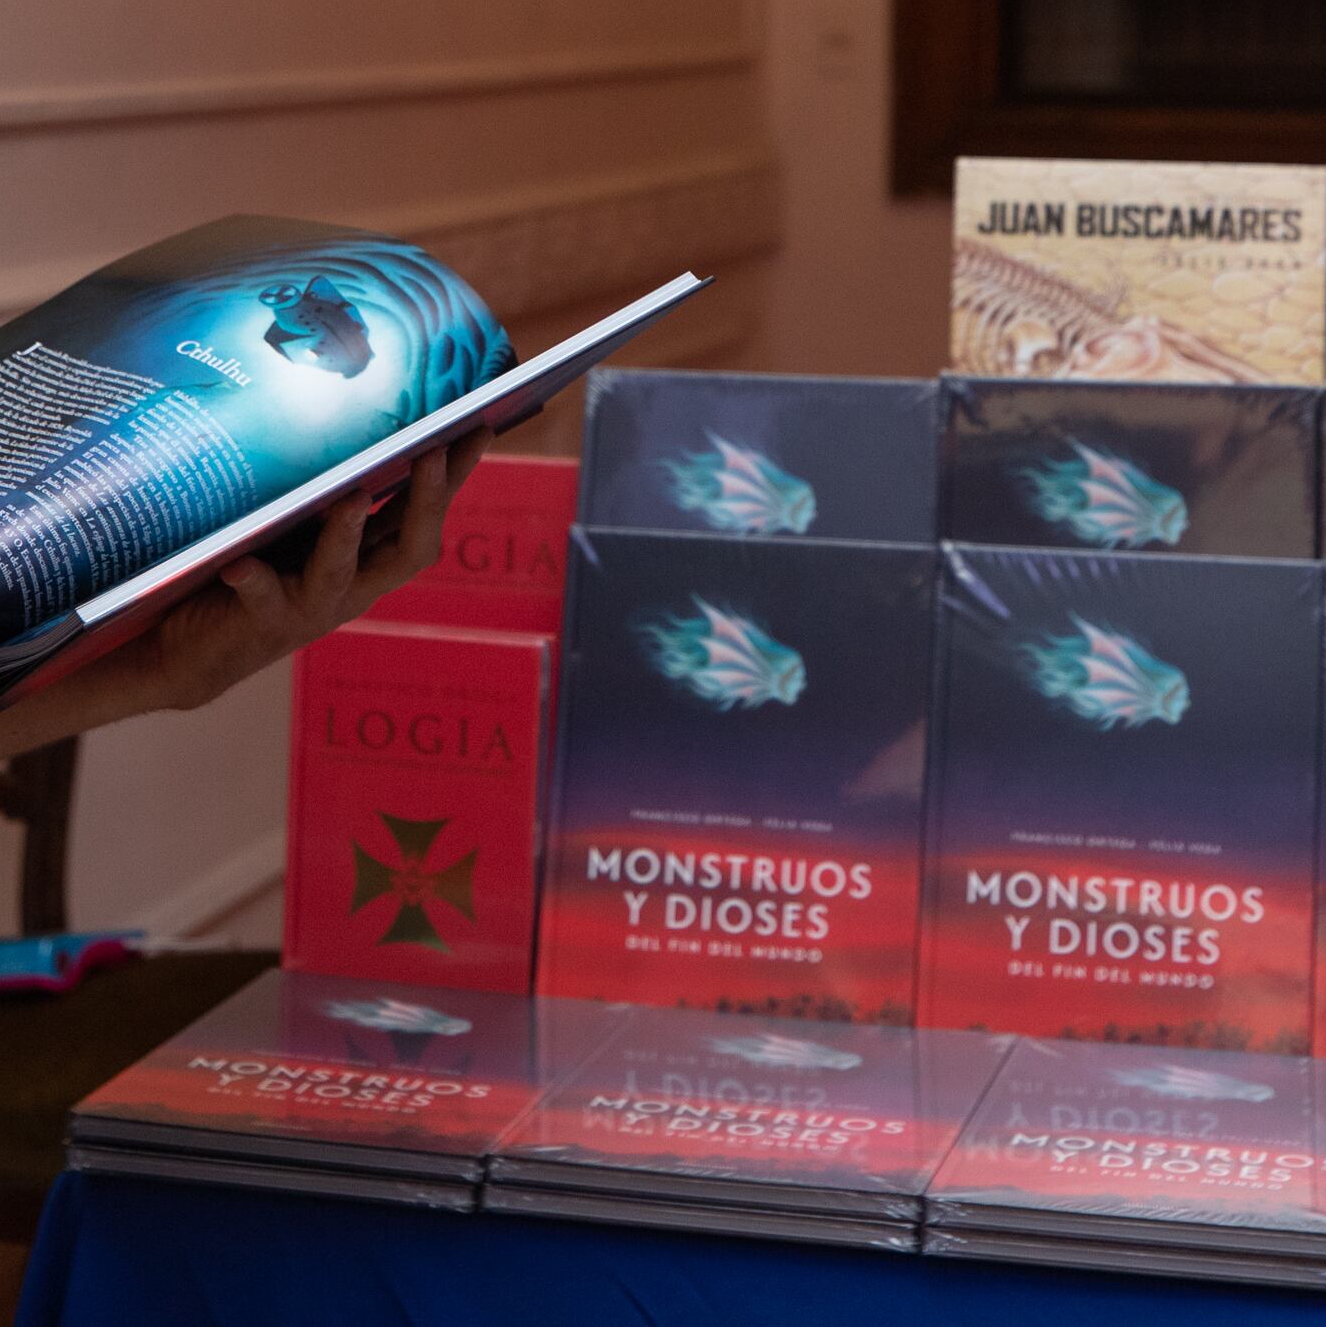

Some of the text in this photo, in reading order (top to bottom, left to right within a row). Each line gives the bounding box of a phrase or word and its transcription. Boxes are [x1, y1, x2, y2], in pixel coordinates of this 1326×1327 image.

[978, 201, 1303, 243] JUAN BUSCAMARES
[176, 340, 253, 388] Cthulhu
[98, 440, 121, 453] poeta
[117, 452, 133, 464] que
[42, 477, 61, 490] Julio
[59, 488, 80, 507] Verne
[63, 465, 89, 484] nombre
[95, 491, 108, 505] Las
[106, 505, 125, 540] aventuras
[71, 458, 99, 477] publicó
[103, 485, 130, 520] peripecias
[89, 457, 116, 479] nombre
[123, 490, 140, 512] poeta
[89, 446, 108, 457] gran
[136, 486, 157, 526] huéspedes
[15, 524, 35, 547] donde
[28, 505, 44, 520] Este
[41, 517, 61, 543] último
[30, 523, 45, 540] dios
[40, 488, 66, 509] escritor
[63, 508, 94, 564] norteamericano
[74, 486, 97, 509] fueron
[94, 508, 116, 552] continuadas
[0, 541, 12, 556] otra
[456, 532, 558, 574] GIA
[325, 707, 514, 761] LOGIA
[586, 846, 873, 899] MONSTRUOS
[623, 891, 830, 941] Y DIOSES
[965, 869, 1266, 925] MONSTRUOS
[1004, 915, 1221, 966] Y DIOSES
[187, 1057, 491, 1099] MONSTRUOS
[218, 1073, 244, 1086] Y
[256, 1077, 435, 1107] DIOSES
[590, 1095, 905, 1135] MONSTRUOS
[625, 1112, 651, 1125] Y
[668, 1117, 852, 1145] DIOSES
[1051, 1149, 1293, 1183] Y DIOSES
